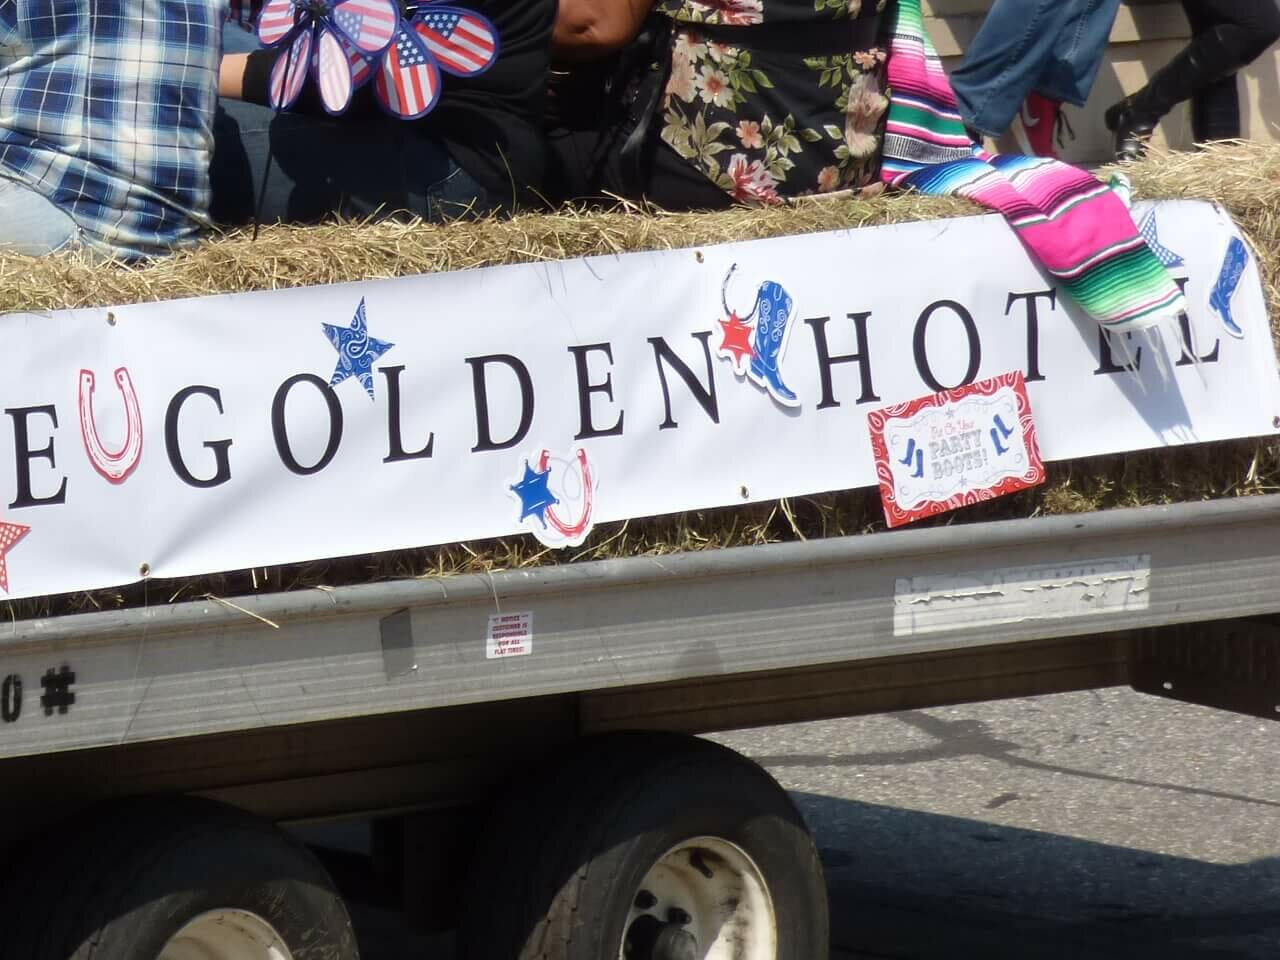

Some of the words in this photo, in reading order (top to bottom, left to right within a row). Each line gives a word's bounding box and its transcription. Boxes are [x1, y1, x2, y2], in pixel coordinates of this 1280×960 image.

[164, 330, 720, 489] GOLDEN
[928, 428, 982, 460] PARTY
[931, 447, 989, 480] BOOTS!
